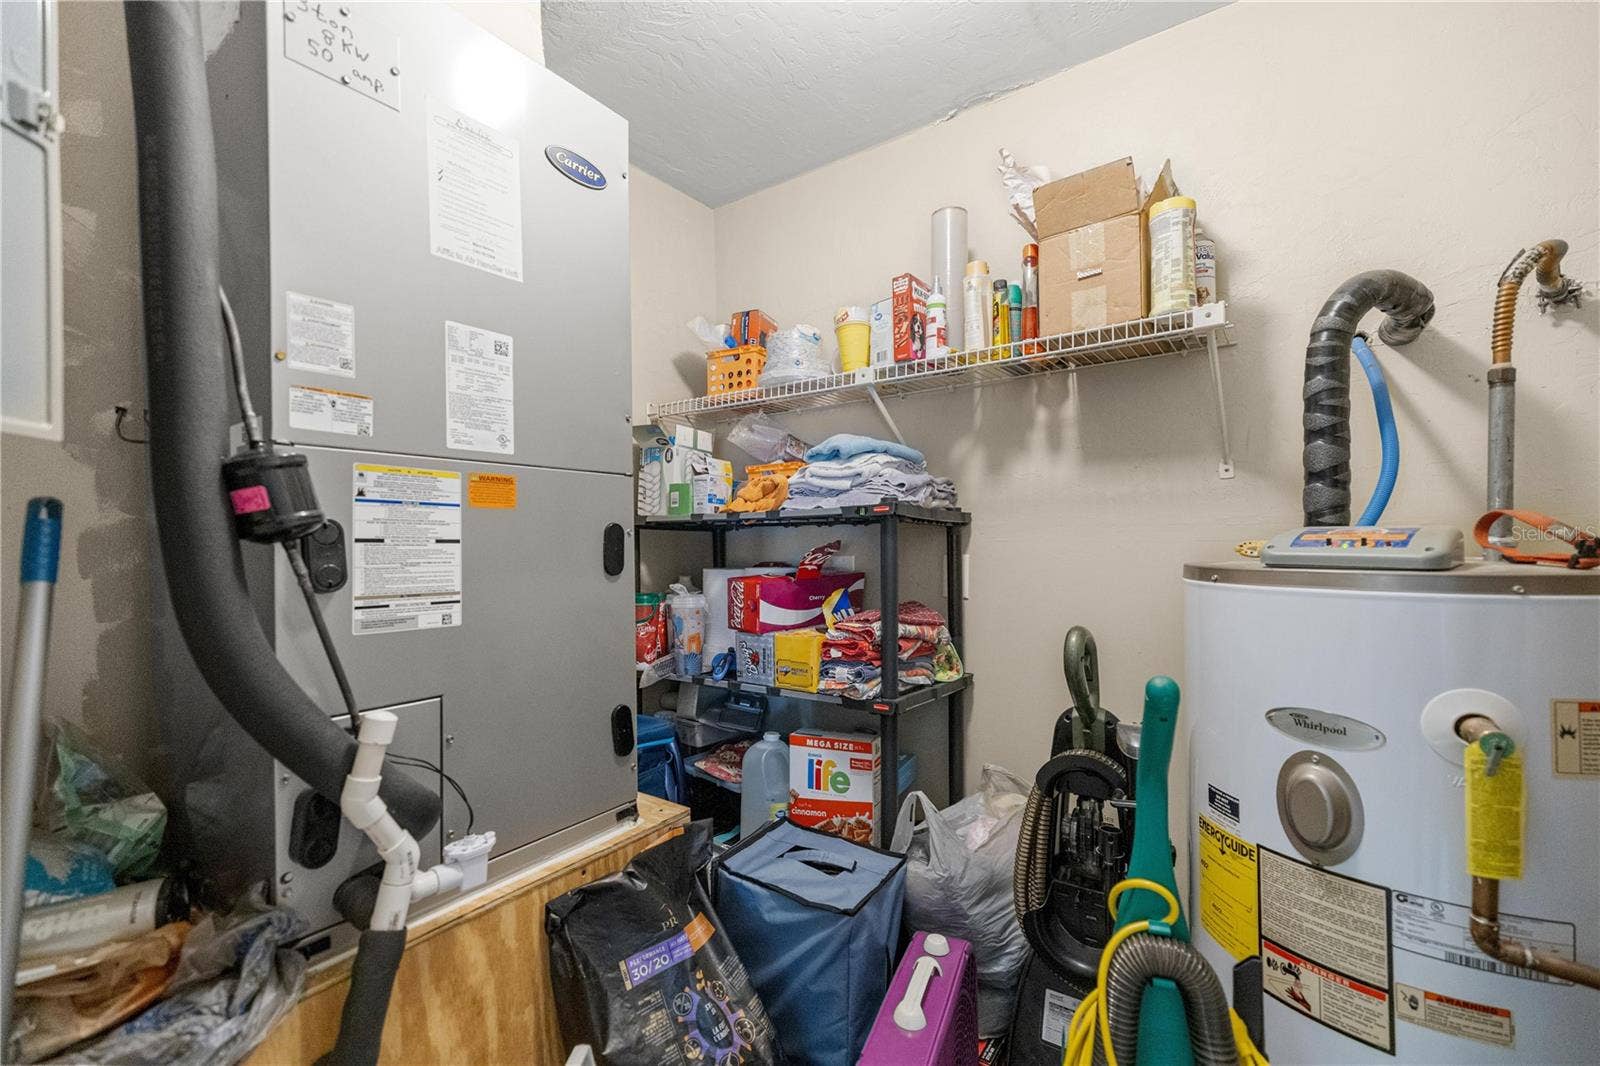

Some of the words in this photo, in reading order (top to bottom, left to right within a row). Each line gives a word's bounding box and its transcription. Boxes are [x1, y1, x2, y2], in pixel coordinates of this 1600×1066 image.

[556, 152, 602, 181] Carrier
[478, 475, 514, 485] WARNING
[1292, 718, 1347, 736] Whirlpool
[806, 739, 832, 749] MEGA
[833, 742, 854, 751] SIZE
[807, 758, 851, 794] life
[791, 806, 827, 817] cinnamon
[631, 954, 670, 981] 30/20
